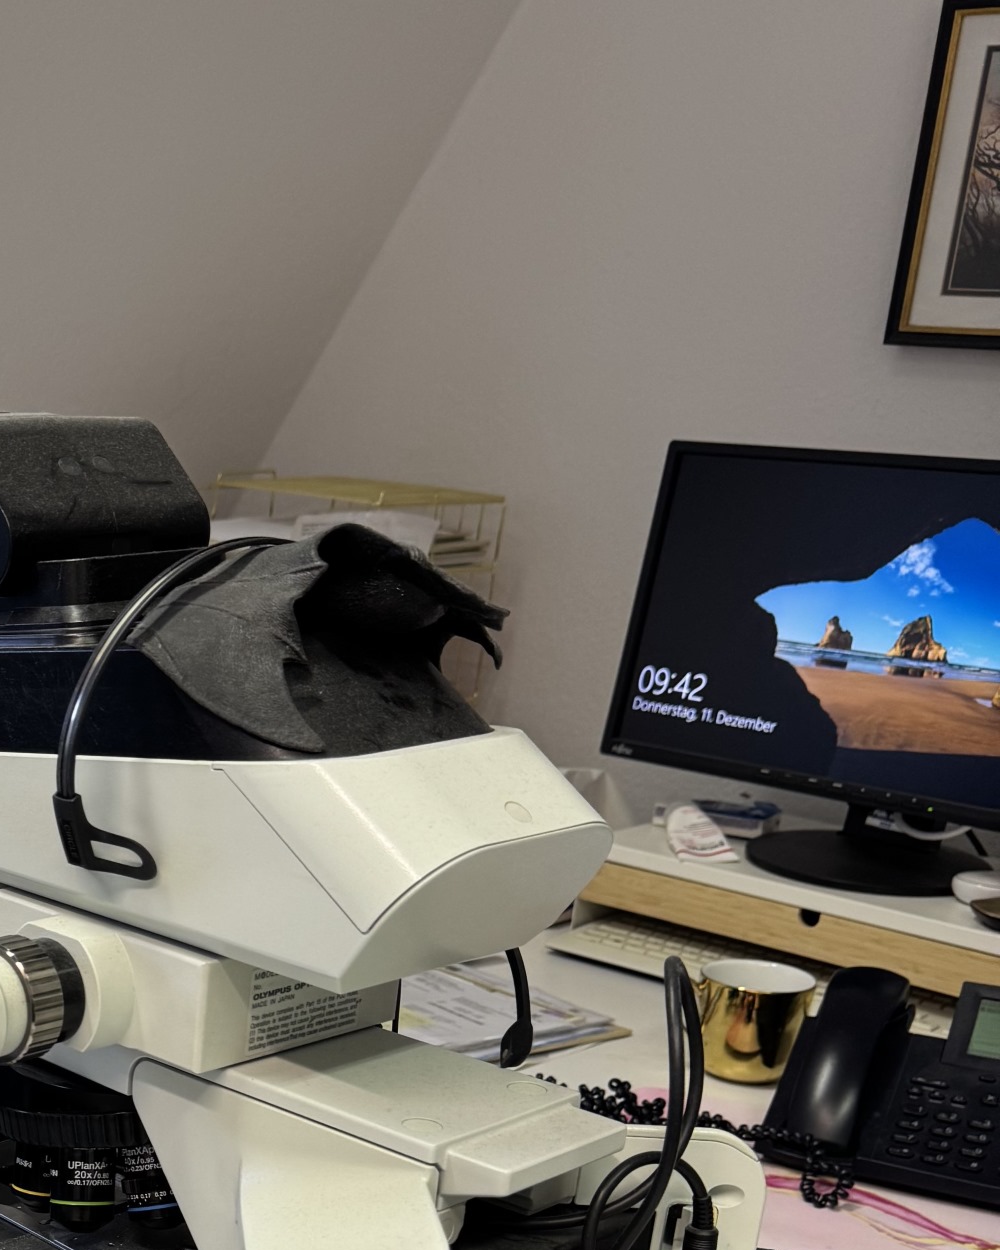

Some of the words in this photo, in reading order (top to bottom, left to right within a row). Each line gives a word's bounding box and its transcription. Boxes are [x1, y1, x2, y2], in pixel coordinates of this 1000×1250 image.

[637, 664, 708, 702] 09:42
[632, 696, 698, 723] Donnerstag,
[715, 710, 777, 734] Dezember
[253, 985, 292, 1001] OLYMPUS
[278, 994, 295, 1003] JAPAN
[67, 1160, 108, 1170] UPlanXA
